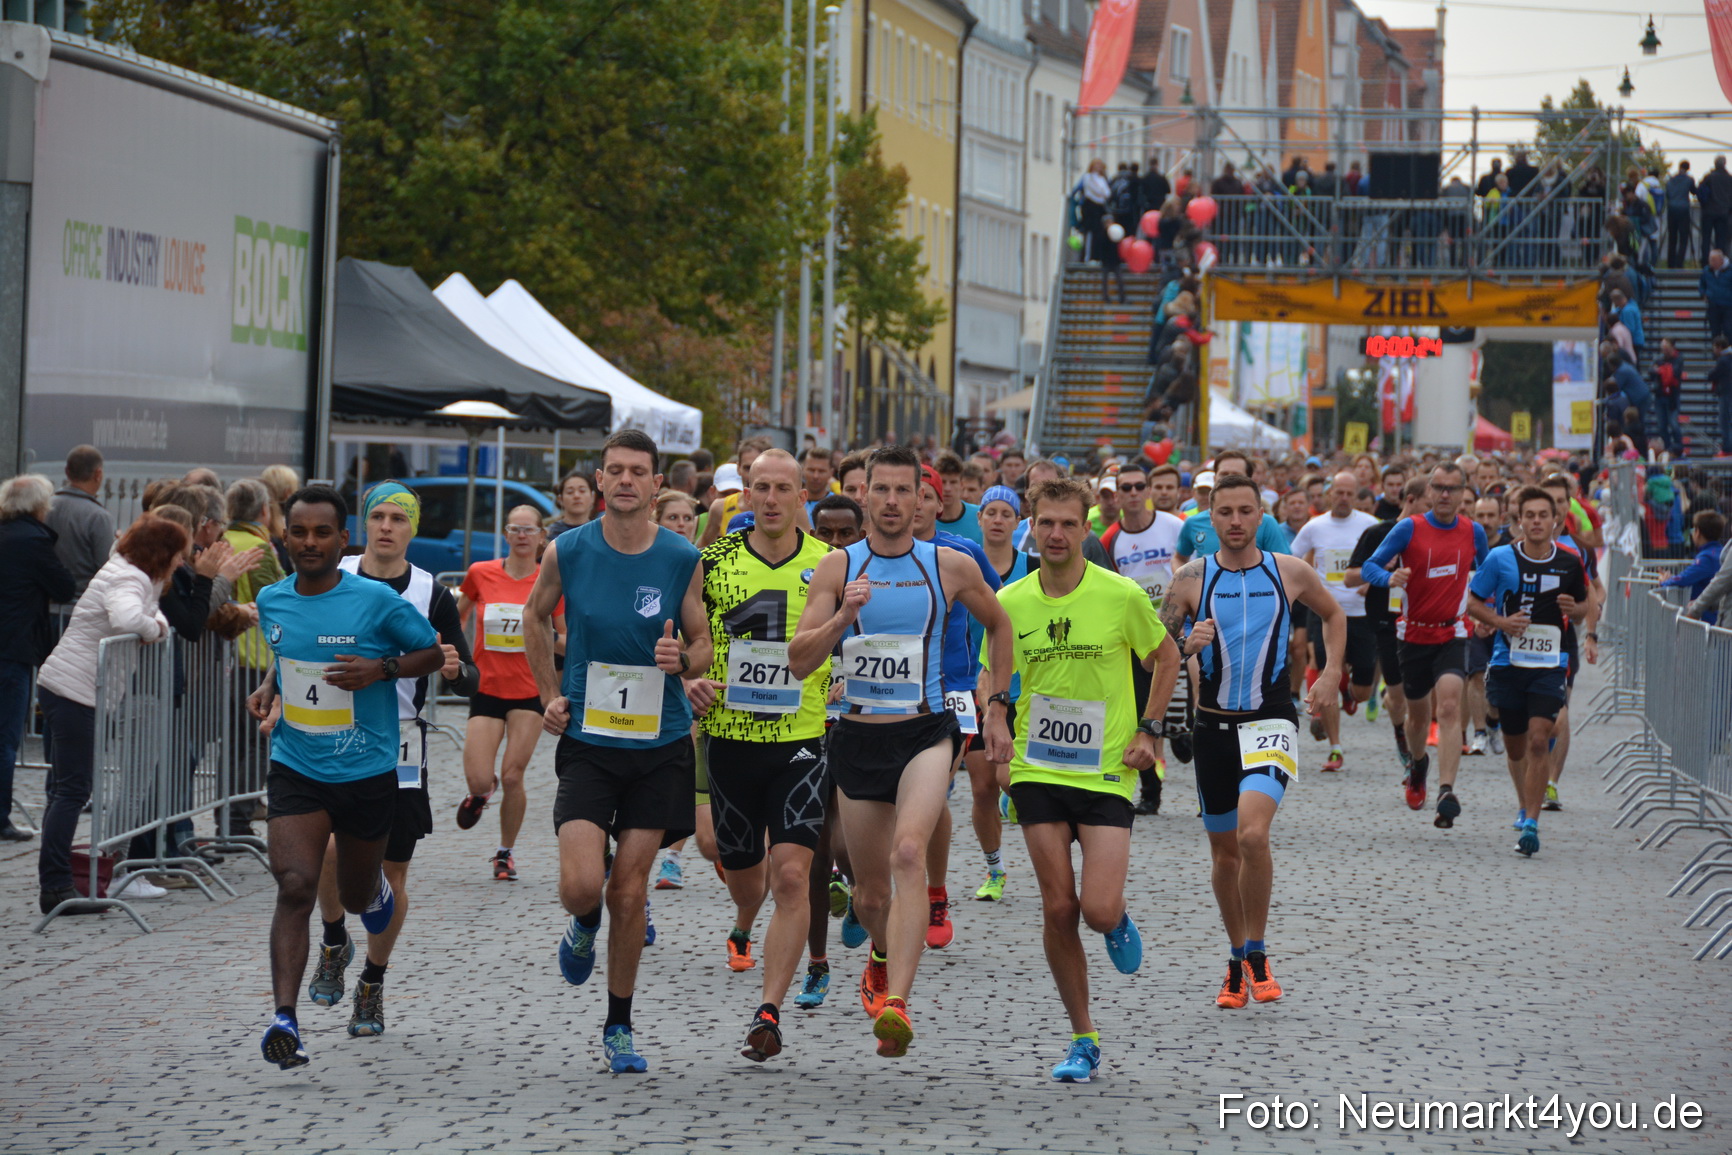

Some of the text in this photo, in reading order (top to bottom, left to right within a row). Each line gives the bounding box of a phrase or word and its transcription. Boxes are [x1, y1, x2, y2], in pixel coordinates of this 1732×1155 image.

[62, 218, 206, 296] OFFICE INDUSTRY LOUNGE
[232, 226, 308, 340] BOCK
[641, 593, 654, 608] TSV
[501, 618, 520, 633] 77
[317, 635, 356, 644] BOCK
[1518, 636, 1553, 652] 2135
[616, 671, 643, 679] BOCK
[739, 662, 790, 685] 2671
[855, 656, 910, 679] 2704
[305, 684, 319, 706] 4
[751, 690, 778, 701] Florian
[870, 685, 895, 695] Marco
[618, 687, 629, 709] 1
[1056, 704, 1083, 713] BOCK
[609, 715, 635, 726] Stefan
[1038, 718, 1092, 745] 2000
[1256, 733, 1289, 752] 275
[1047, 748, 1078, 760] Michael
[1266, 750, 1285, 762] Lukas
